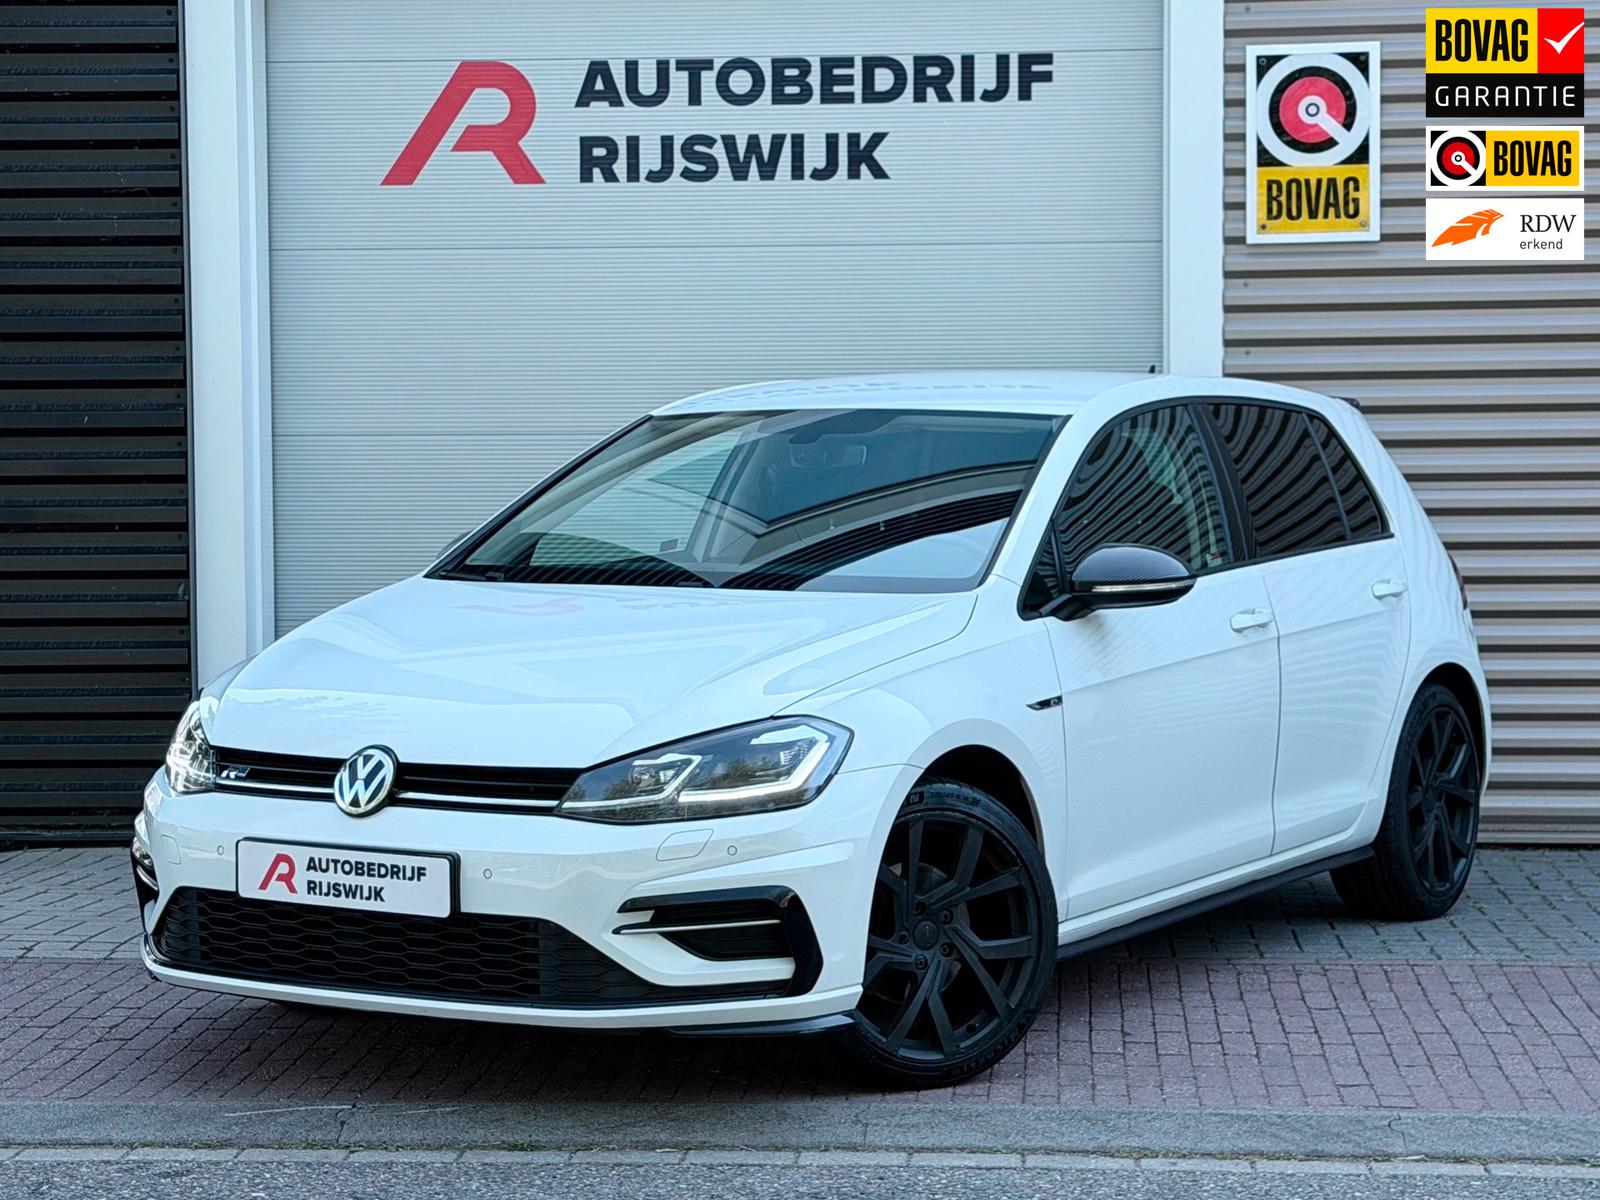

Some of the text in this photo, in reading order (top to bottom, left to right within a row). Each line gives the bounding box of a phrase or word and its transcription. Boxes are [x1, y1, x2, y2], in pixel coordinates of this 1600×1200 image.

[574, 52, 1054, 108] AUTOBEDRIJF
[578, 131, 891, 184] RIJSWIJK
[1265, 176, 1361, 221] BOVAG
[306, 856, 427, 882] AUTOBEDRIJF
[307, 880, 385, 902] RIJSWIJK
